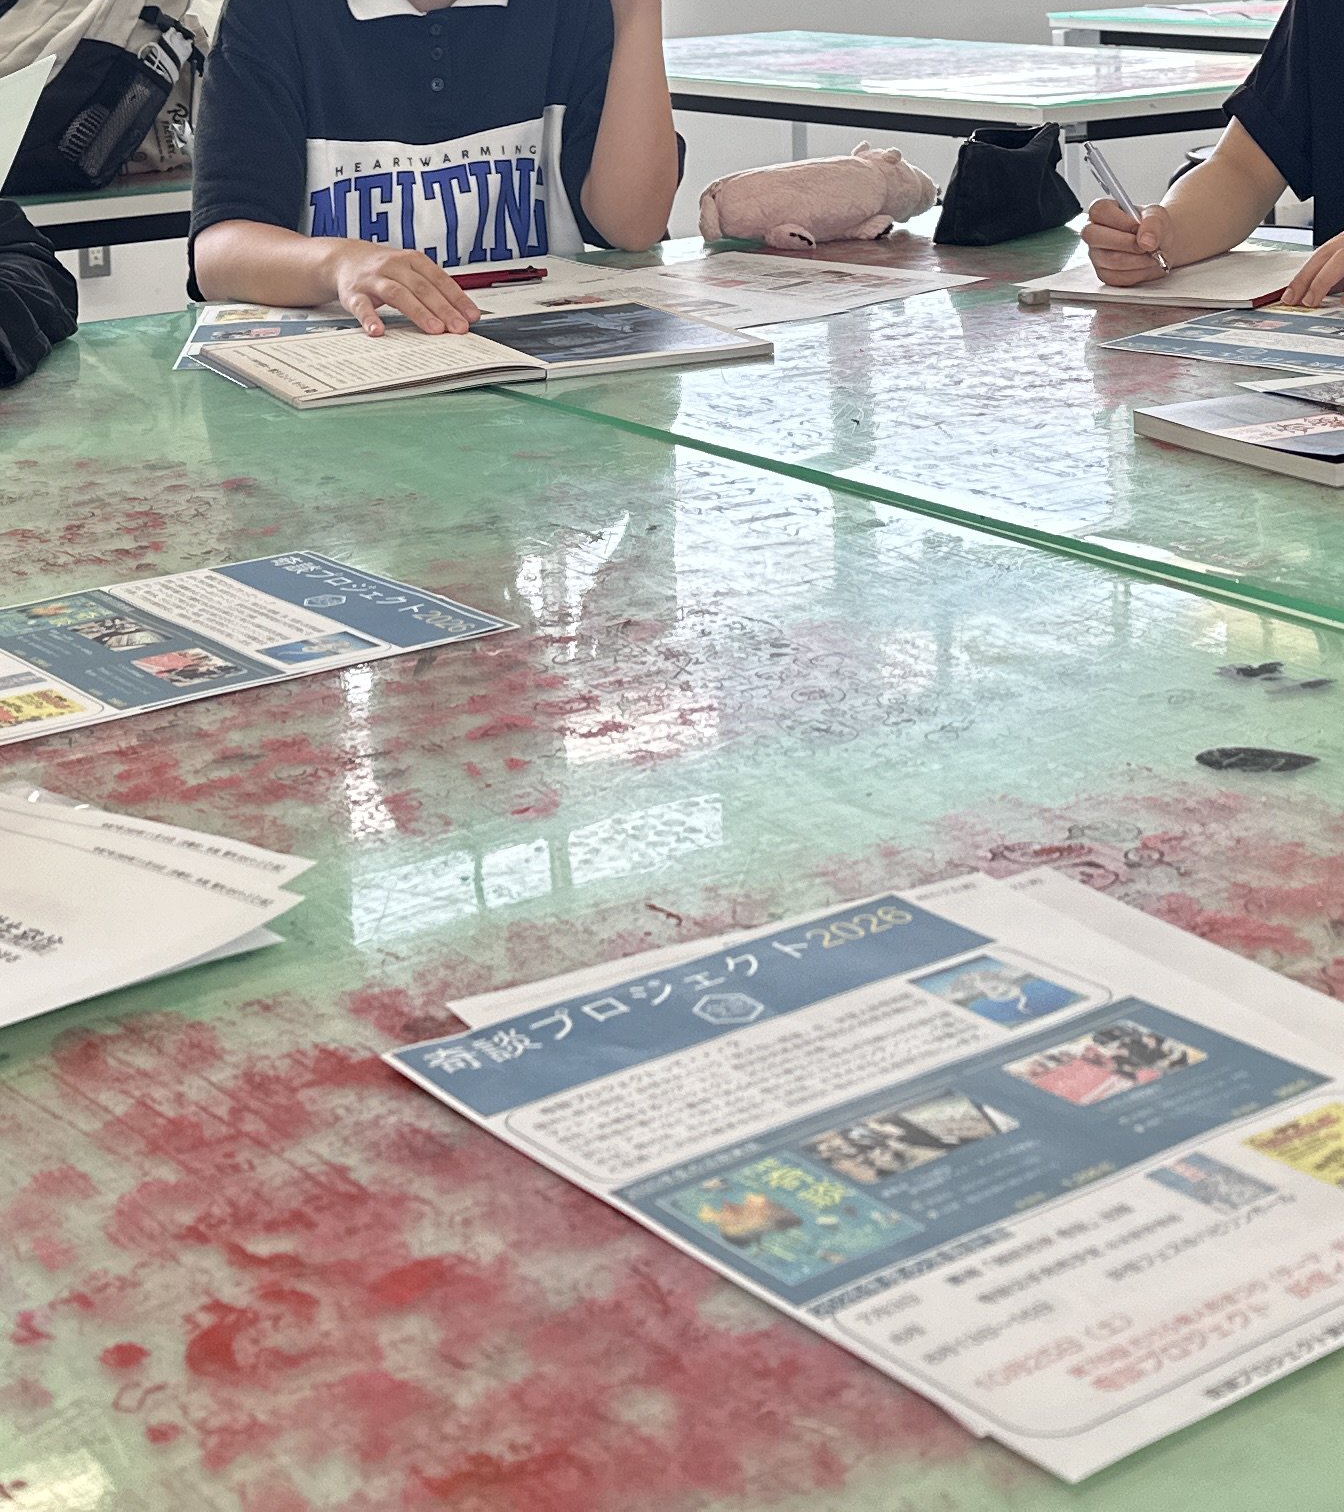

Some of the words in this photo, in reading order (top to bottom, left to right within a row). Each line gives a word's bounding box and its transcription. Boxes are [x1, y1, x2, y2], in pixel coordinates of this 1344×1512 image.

[335, 144, 538, 178] HEARTWARMING
[269, 553, 478, 635] 奇談プロジェクト2026
[423, 905, 914, 1076] 奇談プロジェクト2026
